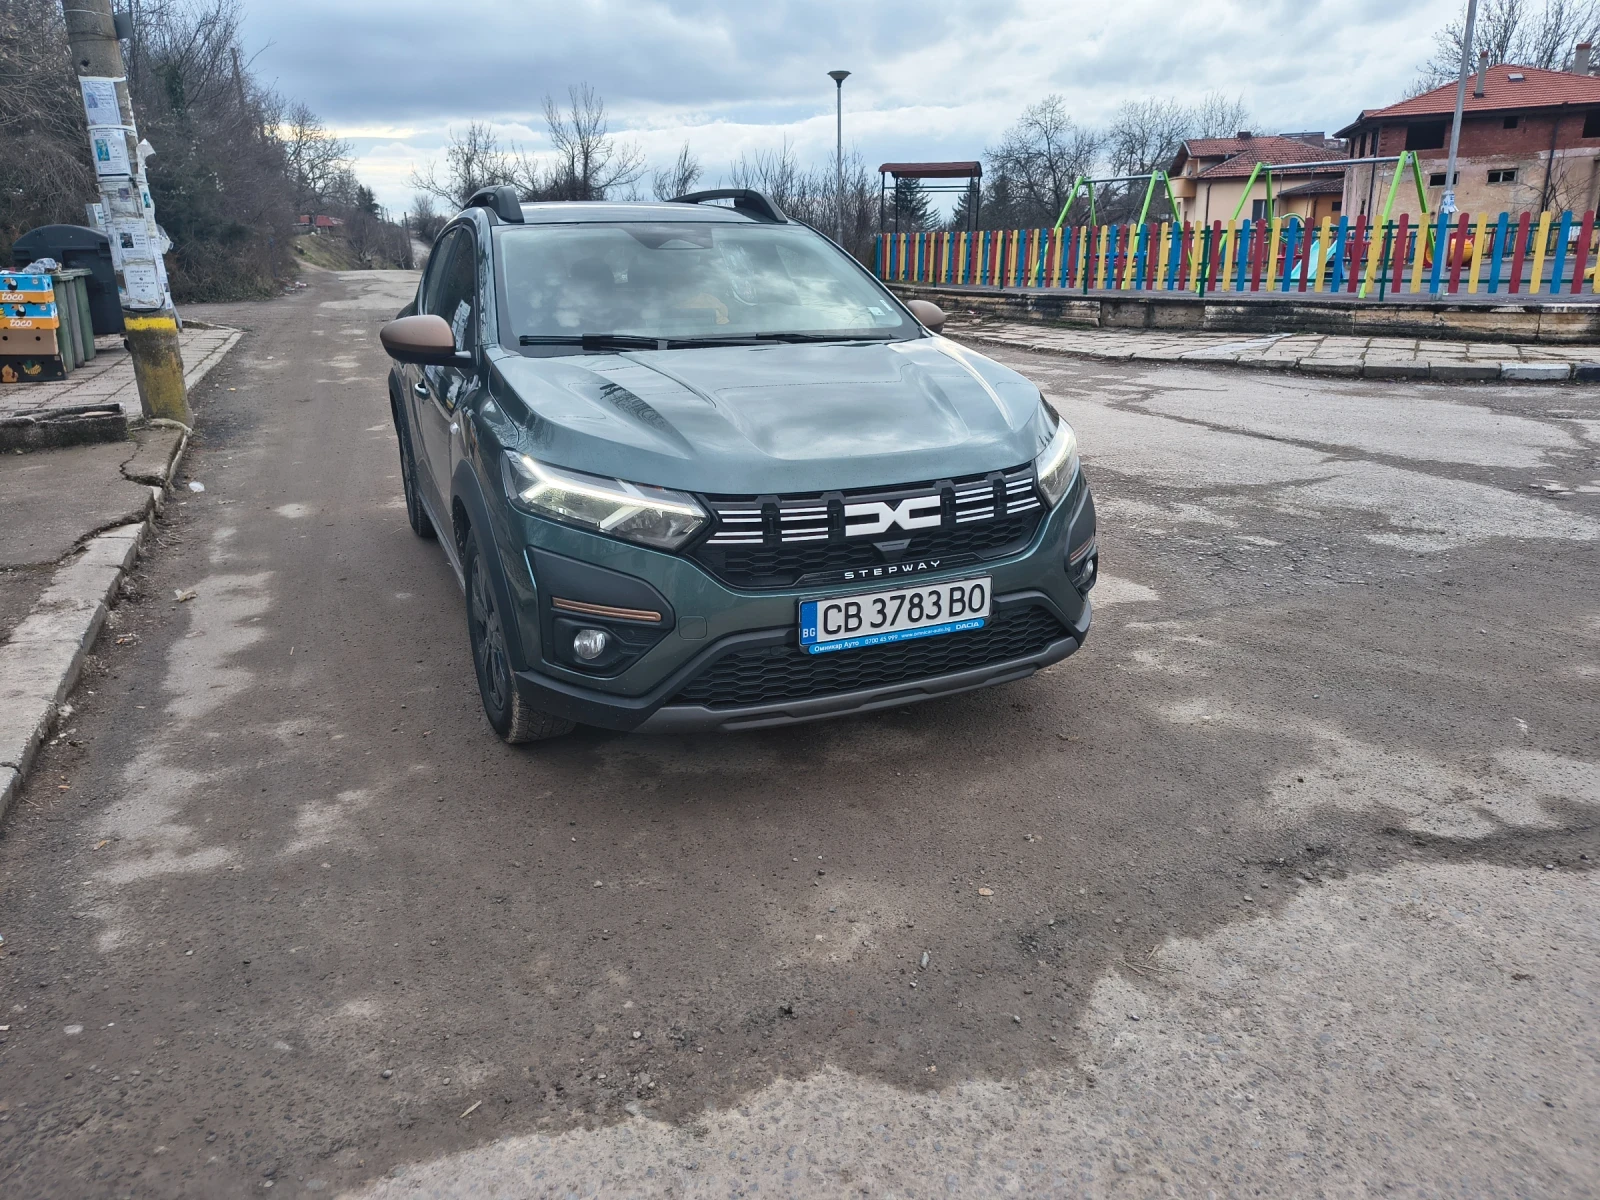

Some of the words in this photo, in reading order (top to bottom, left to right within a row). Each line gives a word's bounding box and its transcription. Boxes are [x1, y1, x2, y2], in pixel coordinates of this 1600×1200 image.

[2, 292, 24, 301] toco
[10, 319, 32, 327] toco
[844, 560, 940, 579] STEPWAY
[823, 601, 863, 636] CB
[870, 590, 942, 629] 3783
[948, 583, 986, 618] BO
[802, 628, 816, 638] BG
[814, 642, 843, 652] Омникар
[844, 640, 860, 649] Ауто
[865, 637, 879, 645] 0700
[888, 634, 899, 642] 999
[955, 621, 980, 630] DACIA
